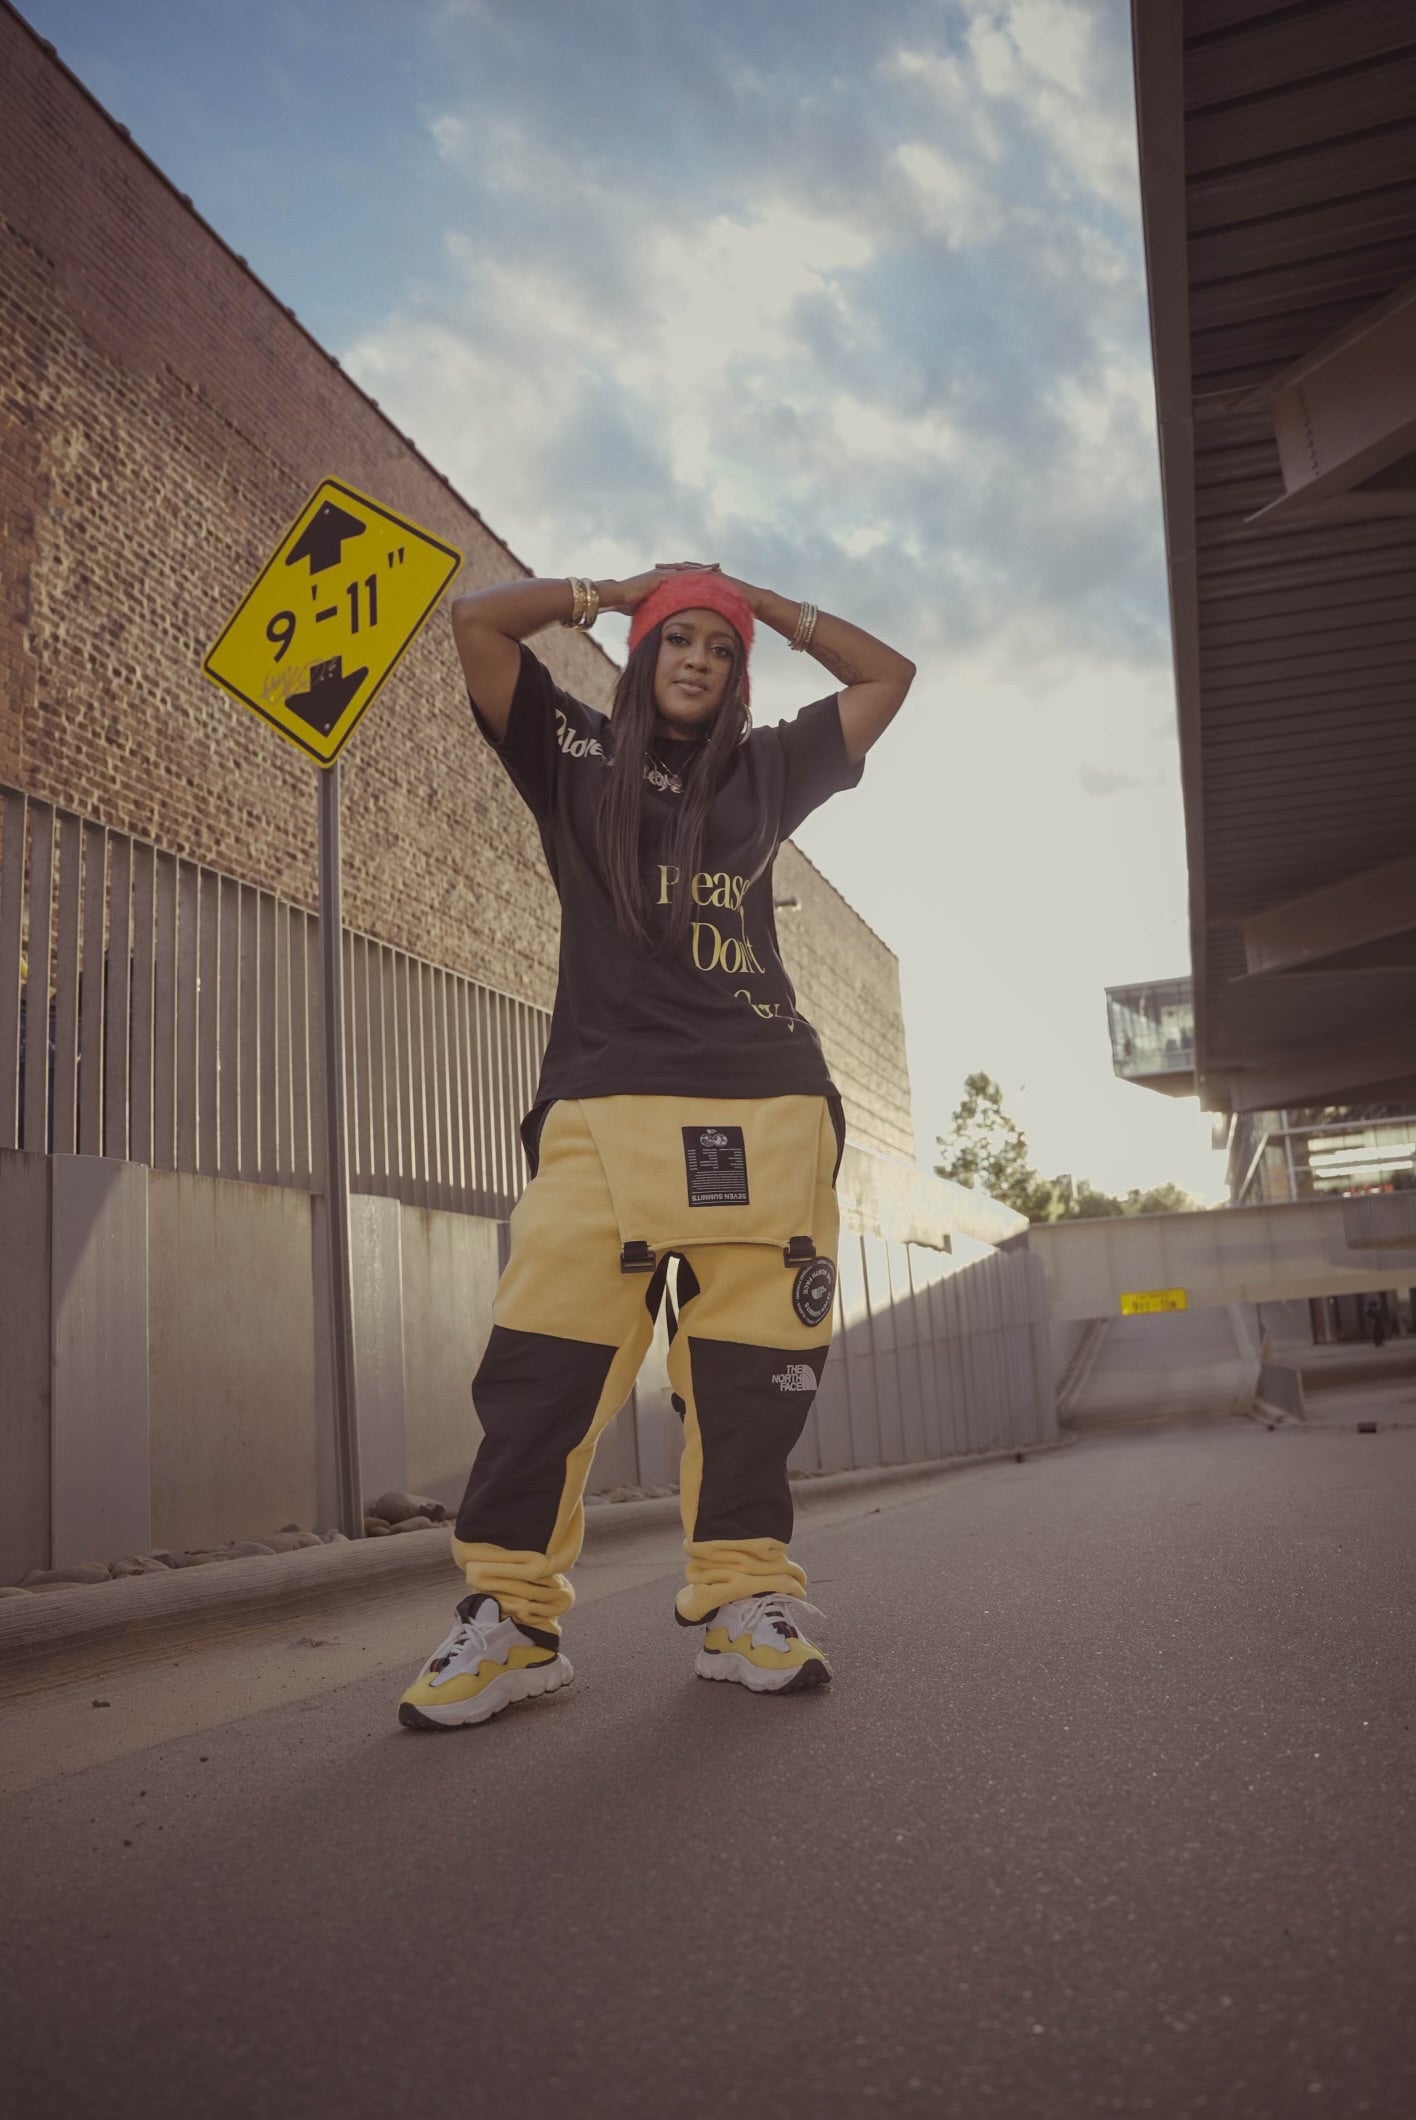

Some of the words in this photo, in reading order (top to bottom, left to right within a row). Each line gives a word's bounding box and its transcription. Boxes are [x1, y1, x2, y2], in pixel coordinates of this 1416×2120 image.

[691, 1194, 723, 1202] SUMMITS
[787, 1364, 803, 1374] THE
[771, 1374, 802, 1383] NORTH
[780, 1382, 803, 1391] FACE
